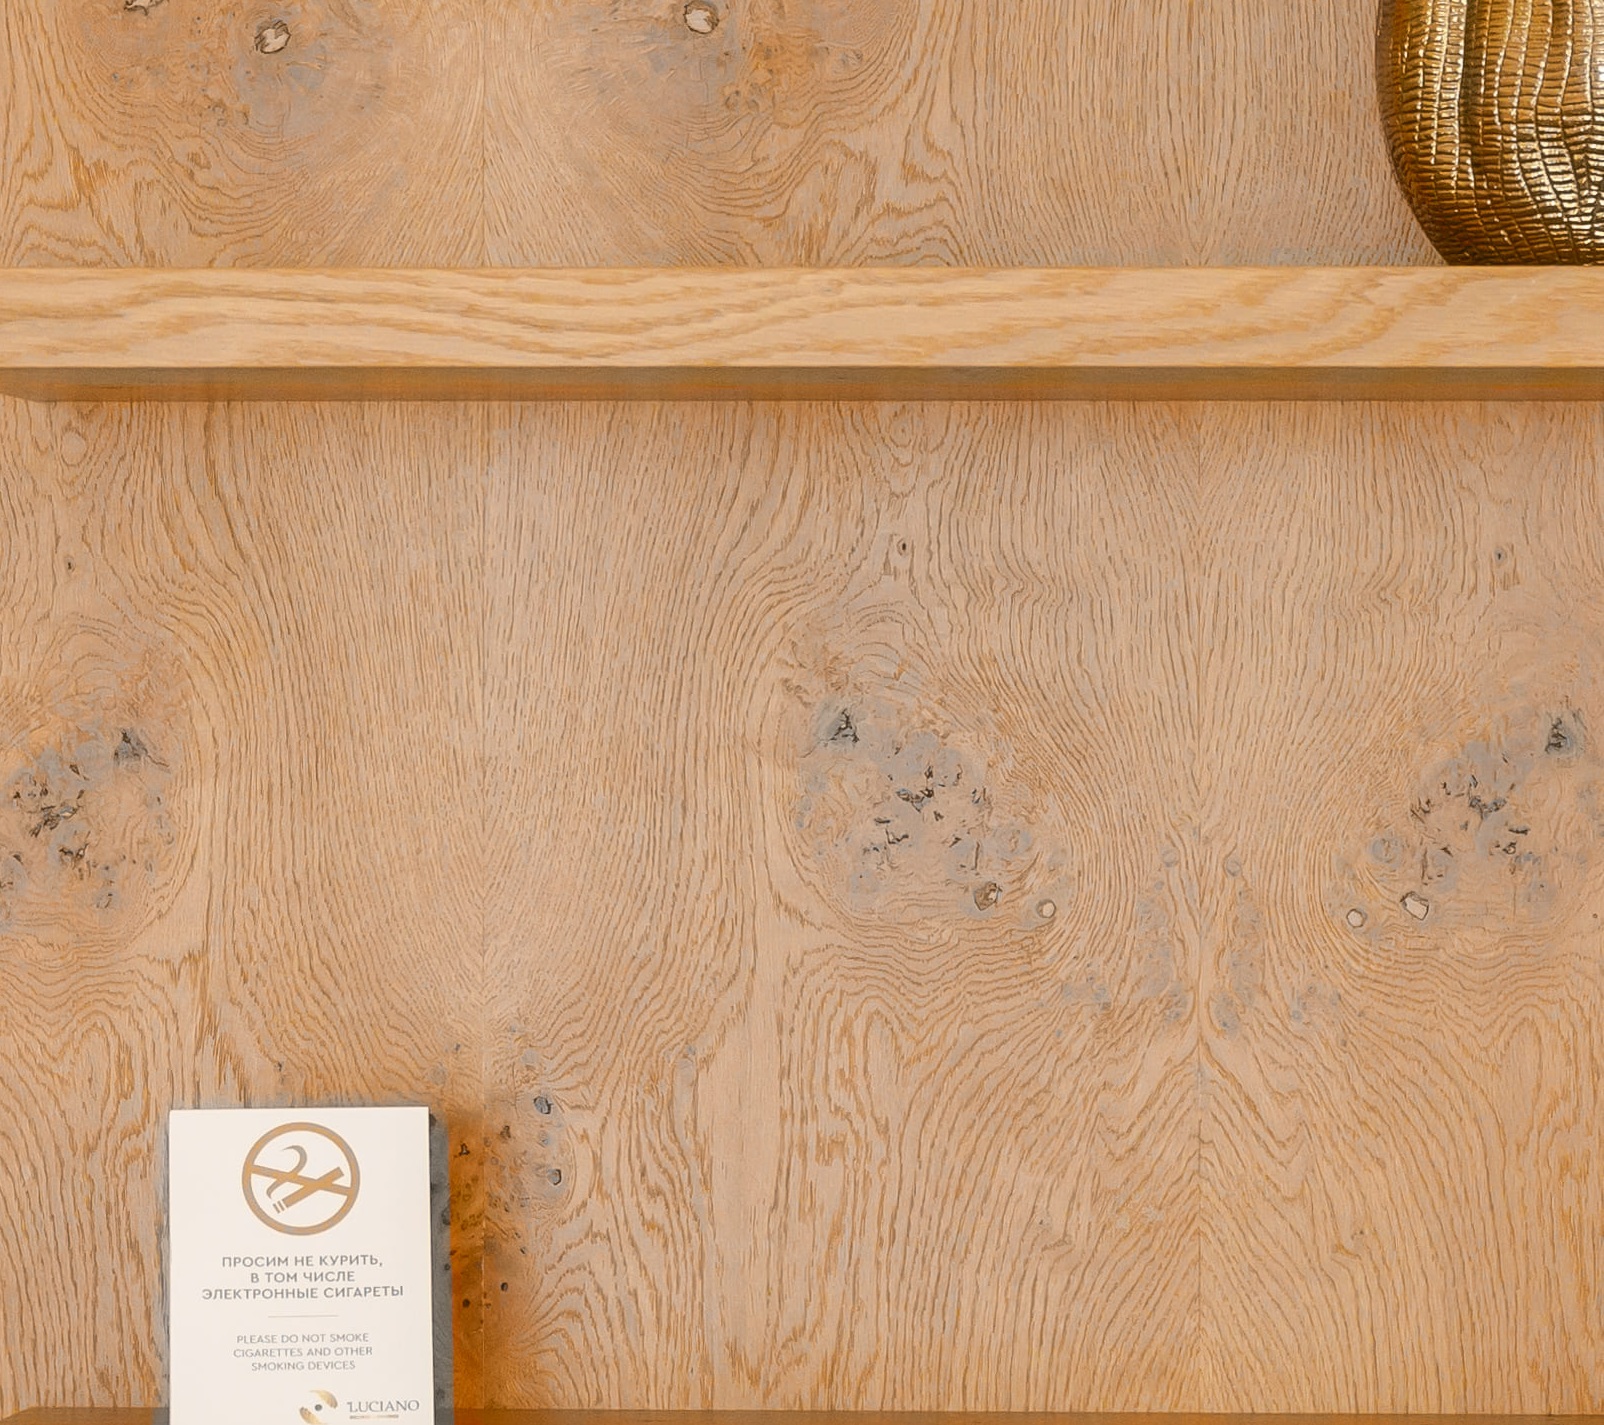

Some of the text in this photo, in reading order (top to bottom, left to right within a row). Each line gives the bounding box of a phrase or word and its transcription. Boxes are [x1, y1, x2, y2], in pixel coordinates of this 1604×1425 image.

[222, 1254, 384, 1268] ПРОСИМ НЕ КУРИТЬ,
[250, 1271, 356, 1283] В ТОМ ЧИСЛЕ
[202, 1285, 404, 1300] ЭЛЕКТРОННЫЕ СИГАРЕТЫ
[236, 1333, 369, 1344] PLEASE DO NOT SMOKE
[233, 1346, 373, 1358] CIGARETTES AND OTHER
[252, 1360, 356, 1371] SMOKING DEVICES
[347, 1399, 420, 1413] LUCIANO
